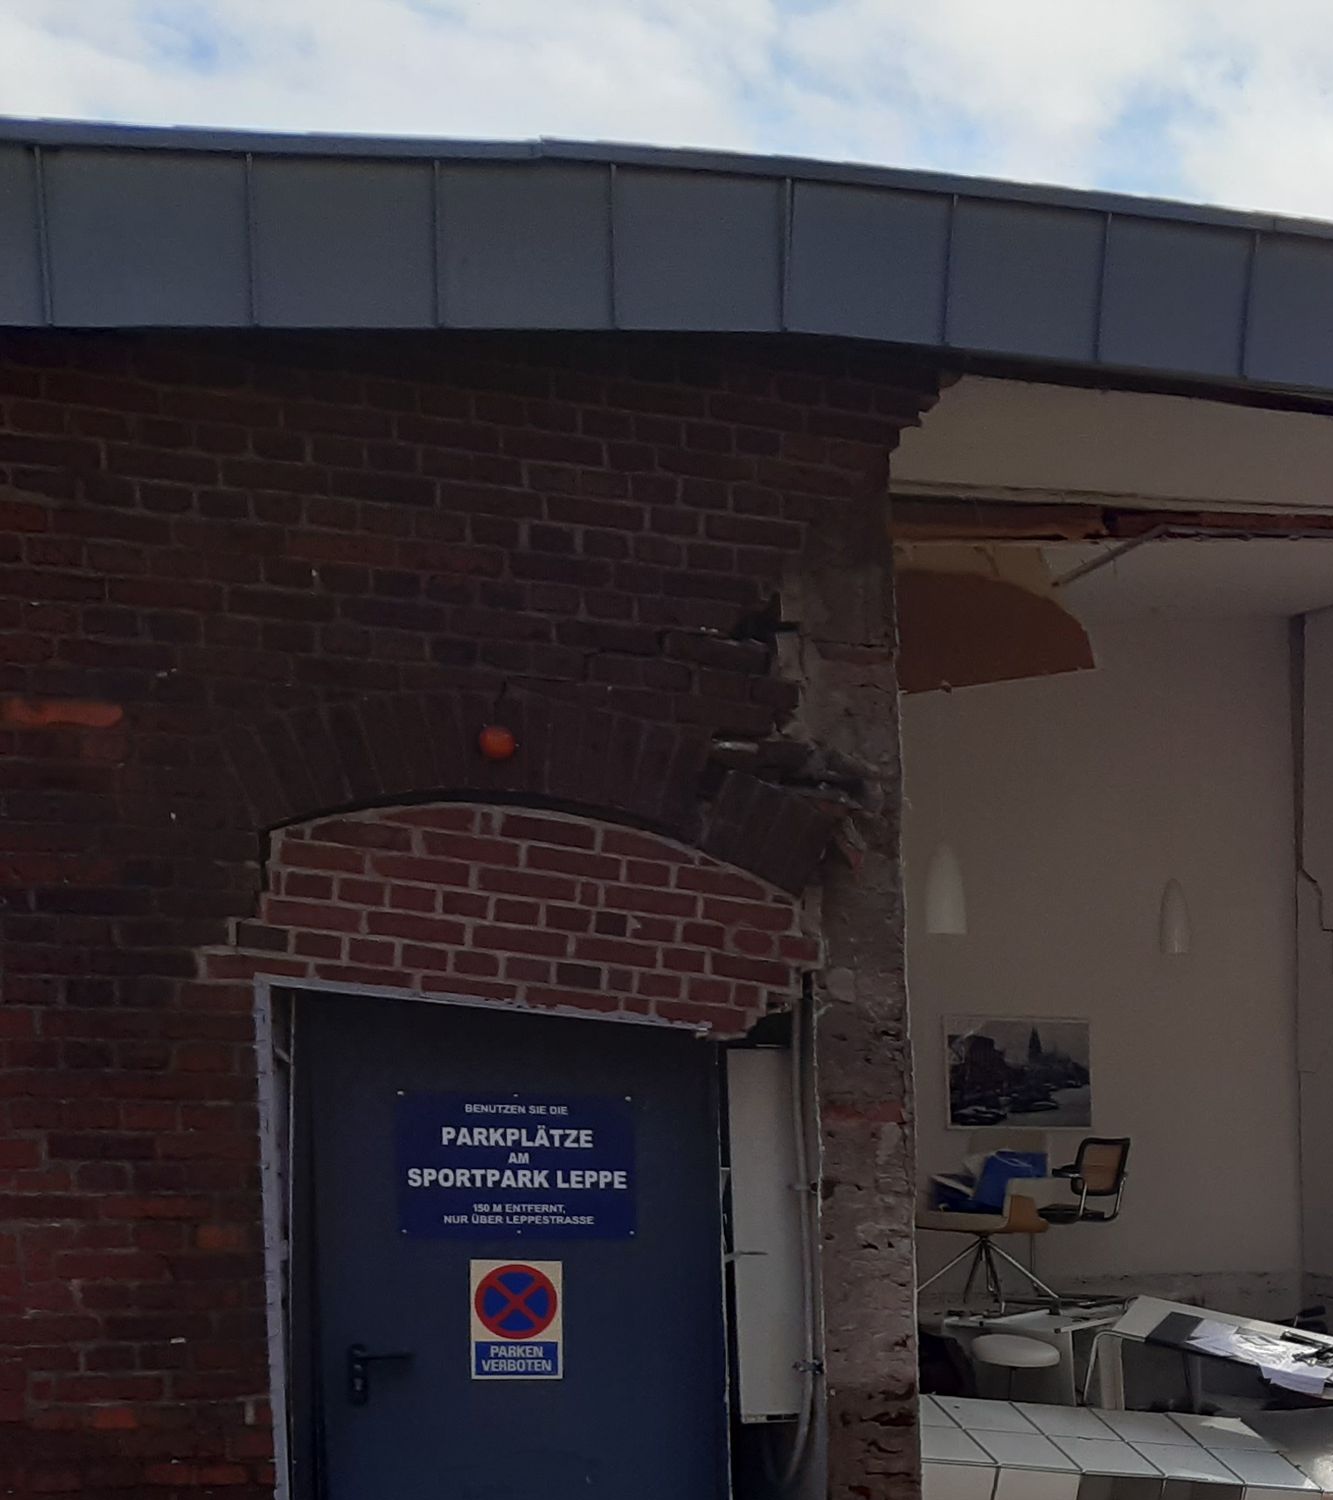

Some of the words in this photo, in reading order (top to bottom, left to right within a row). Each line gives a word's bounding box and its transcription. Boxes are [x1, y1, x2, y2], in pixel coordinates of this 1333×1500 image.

[465, 1104, 526, 1114] BENUTZEN
[529, 1105, 547, 1115] SIE
[549, 1106, 568, 1115] DIE
[441, 1125, 593, 1148] PARKPLÄTZE
[508, 1152, 530, 1164] AM
[407, 1169, 550, 1188] SPORTPARK
[557, 1170, 627, 1189] LEPPE
[473, 1204, 490, 1213] 150
[492, 1204, 502, 1213] M
[505, 1204, 566, 1214] ENTFERNT,
[443, 1215, 468, 1224] NUR
[471, 1213, 503, 1224] ÜBER
[505, 1215, 594, 1225] LEPPESTRASSE
[490, 1345, 543, 1357] PARKEN
[481, 1359, 552, 1371] VERBOTEN
